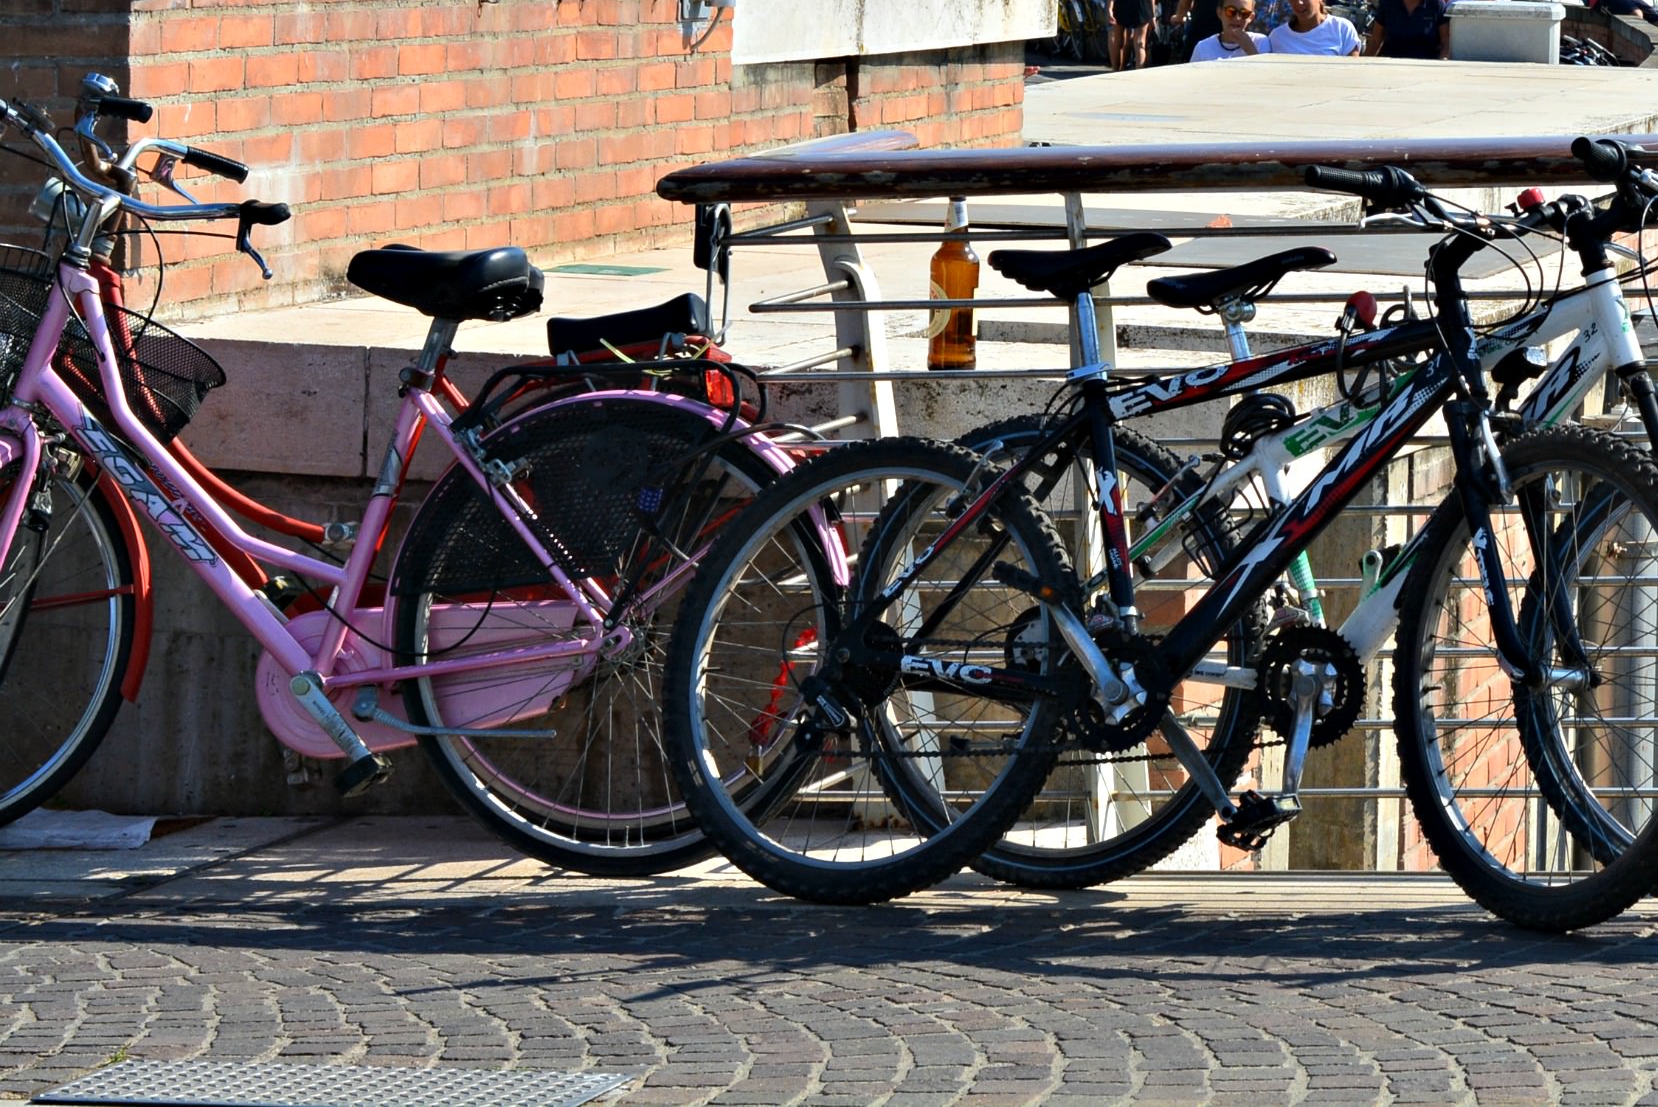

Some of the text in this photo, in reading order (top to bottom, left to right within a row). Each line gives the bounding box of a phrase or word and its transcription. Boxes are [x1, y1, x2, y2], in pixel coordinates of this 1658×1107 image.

[1582, 321, 1599, 344] 32
[1108, 364, 1230, 421] EVO
[900, 654, 992, 684] EVO
